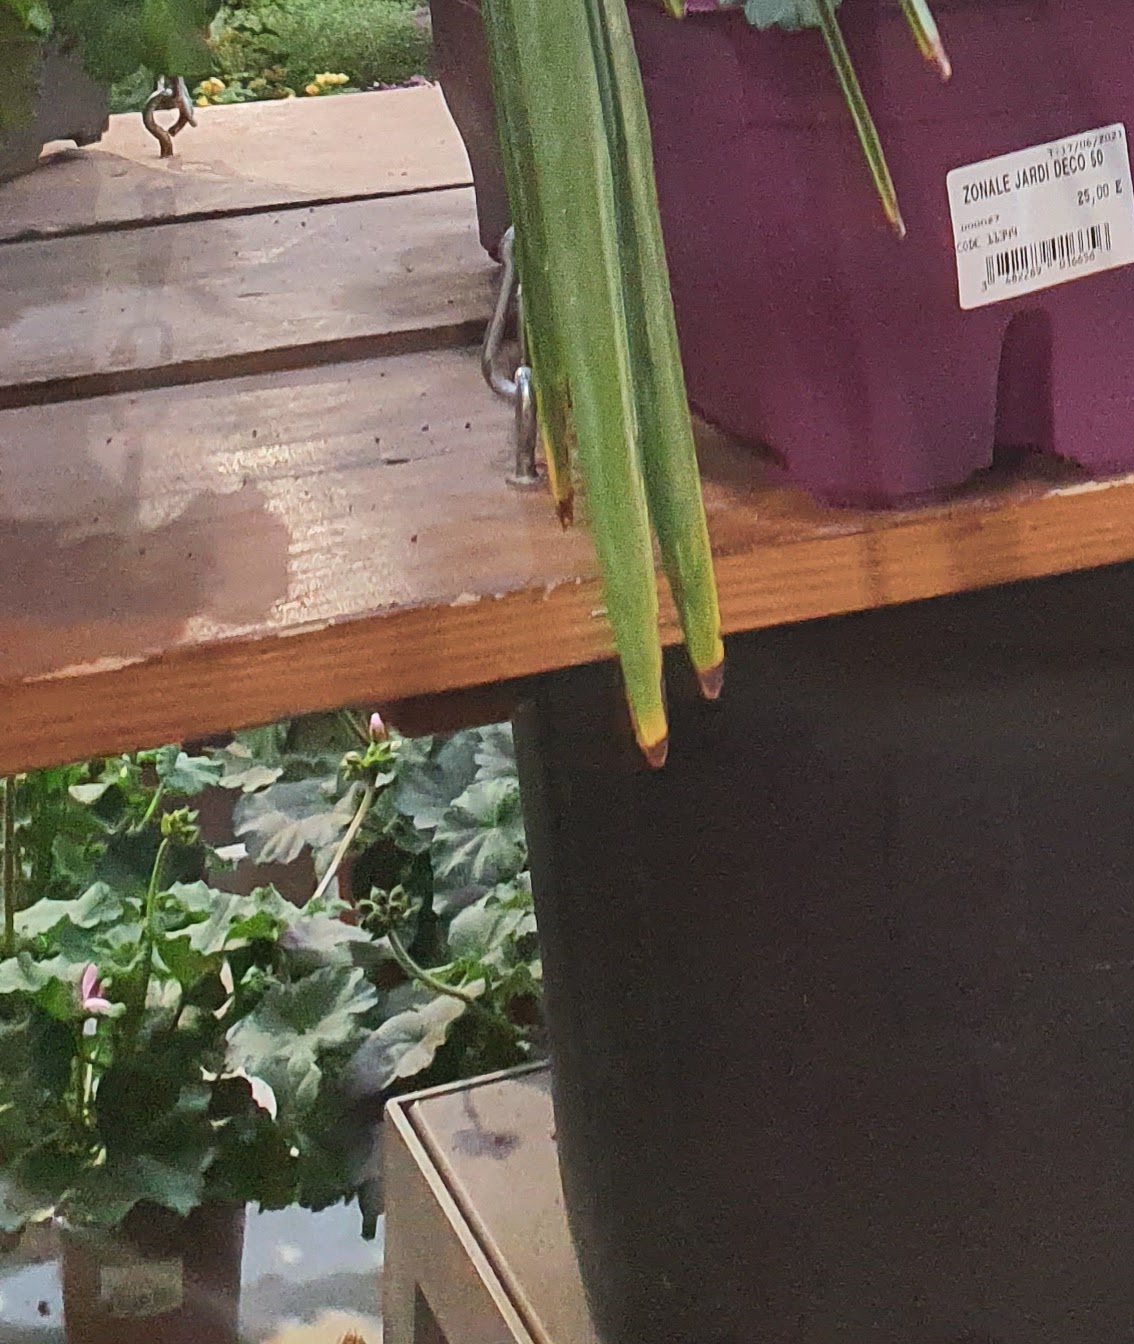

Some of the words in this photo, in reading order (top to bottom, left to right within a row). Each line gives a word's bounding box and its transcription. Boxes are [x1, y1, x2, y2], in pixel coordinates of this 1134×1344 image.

[962, 174, 1011, 205] ZONALE
[1015, 164, 1050, 191] JARDI
[1054, 150, 1086, 179] DECO
